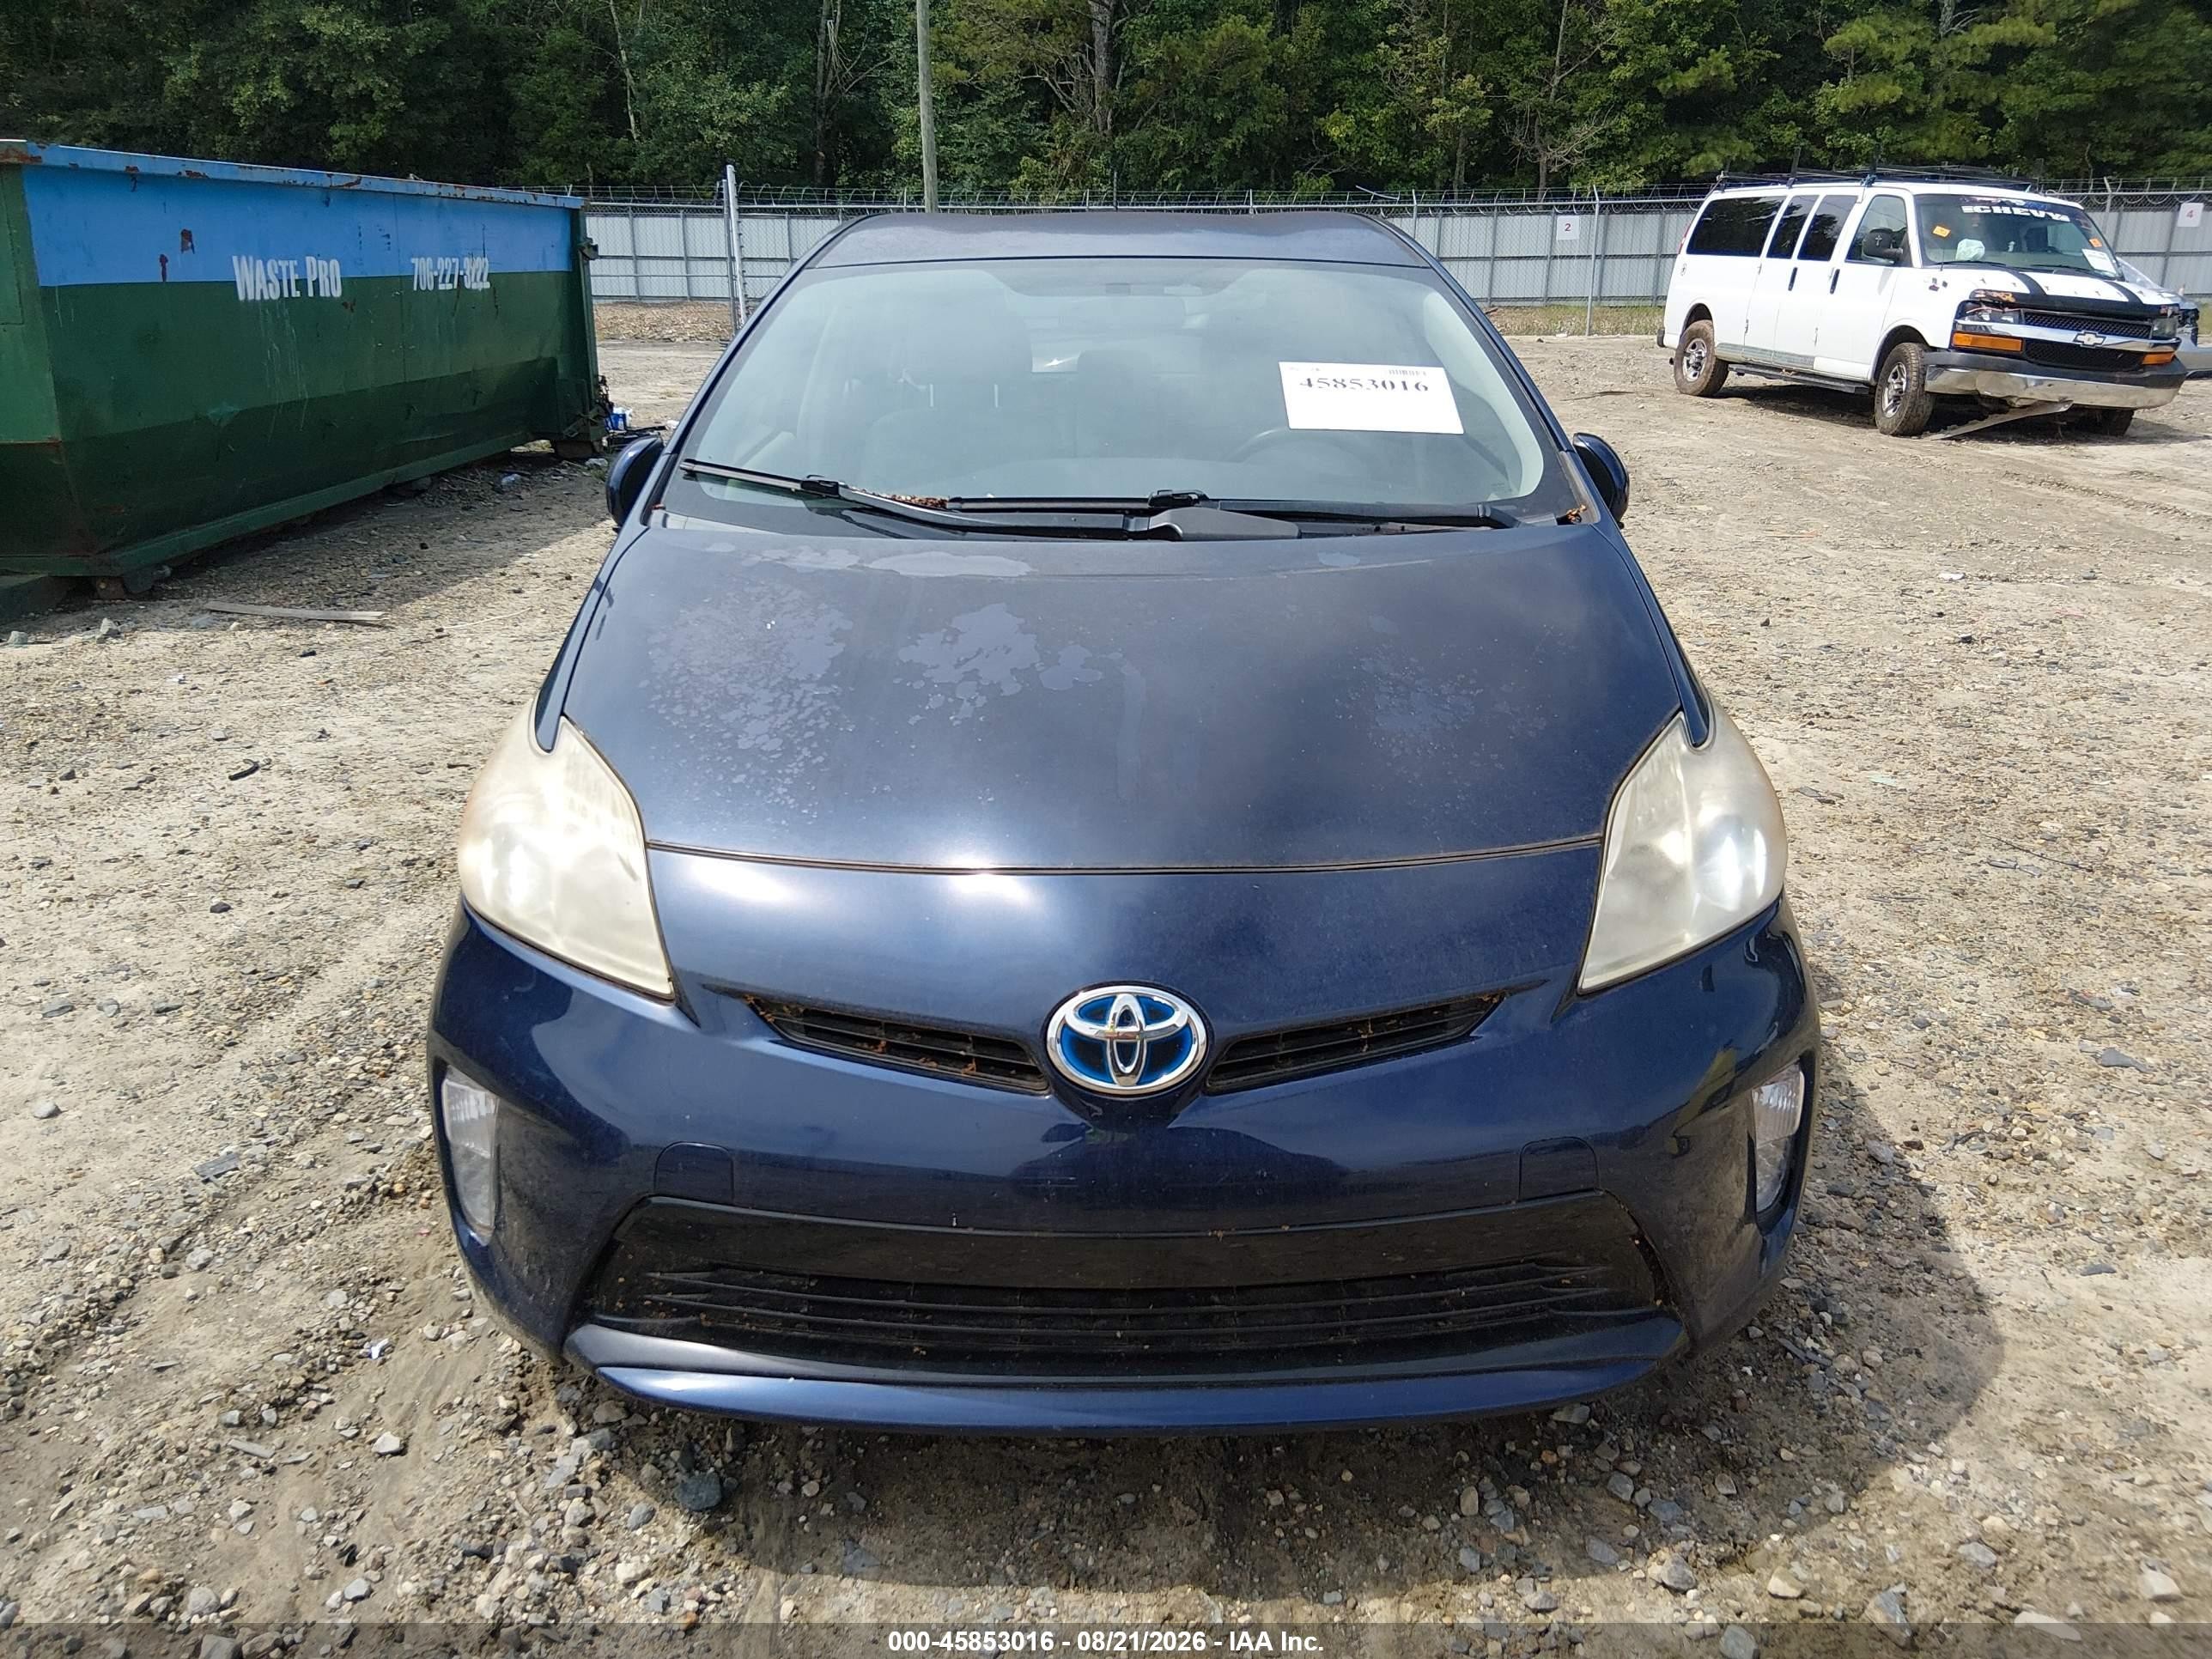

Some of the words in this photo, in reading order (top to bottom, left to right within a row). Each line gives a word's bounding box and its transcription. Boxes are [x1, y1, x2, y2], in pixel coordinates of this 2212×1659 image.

[1973, 205, 2063, 221] CHEVY
[2186, 210, 2194, 219] 4
[1565, 223, 1571, 232] 2
[1299, 378, 1429, 392] 45853016
